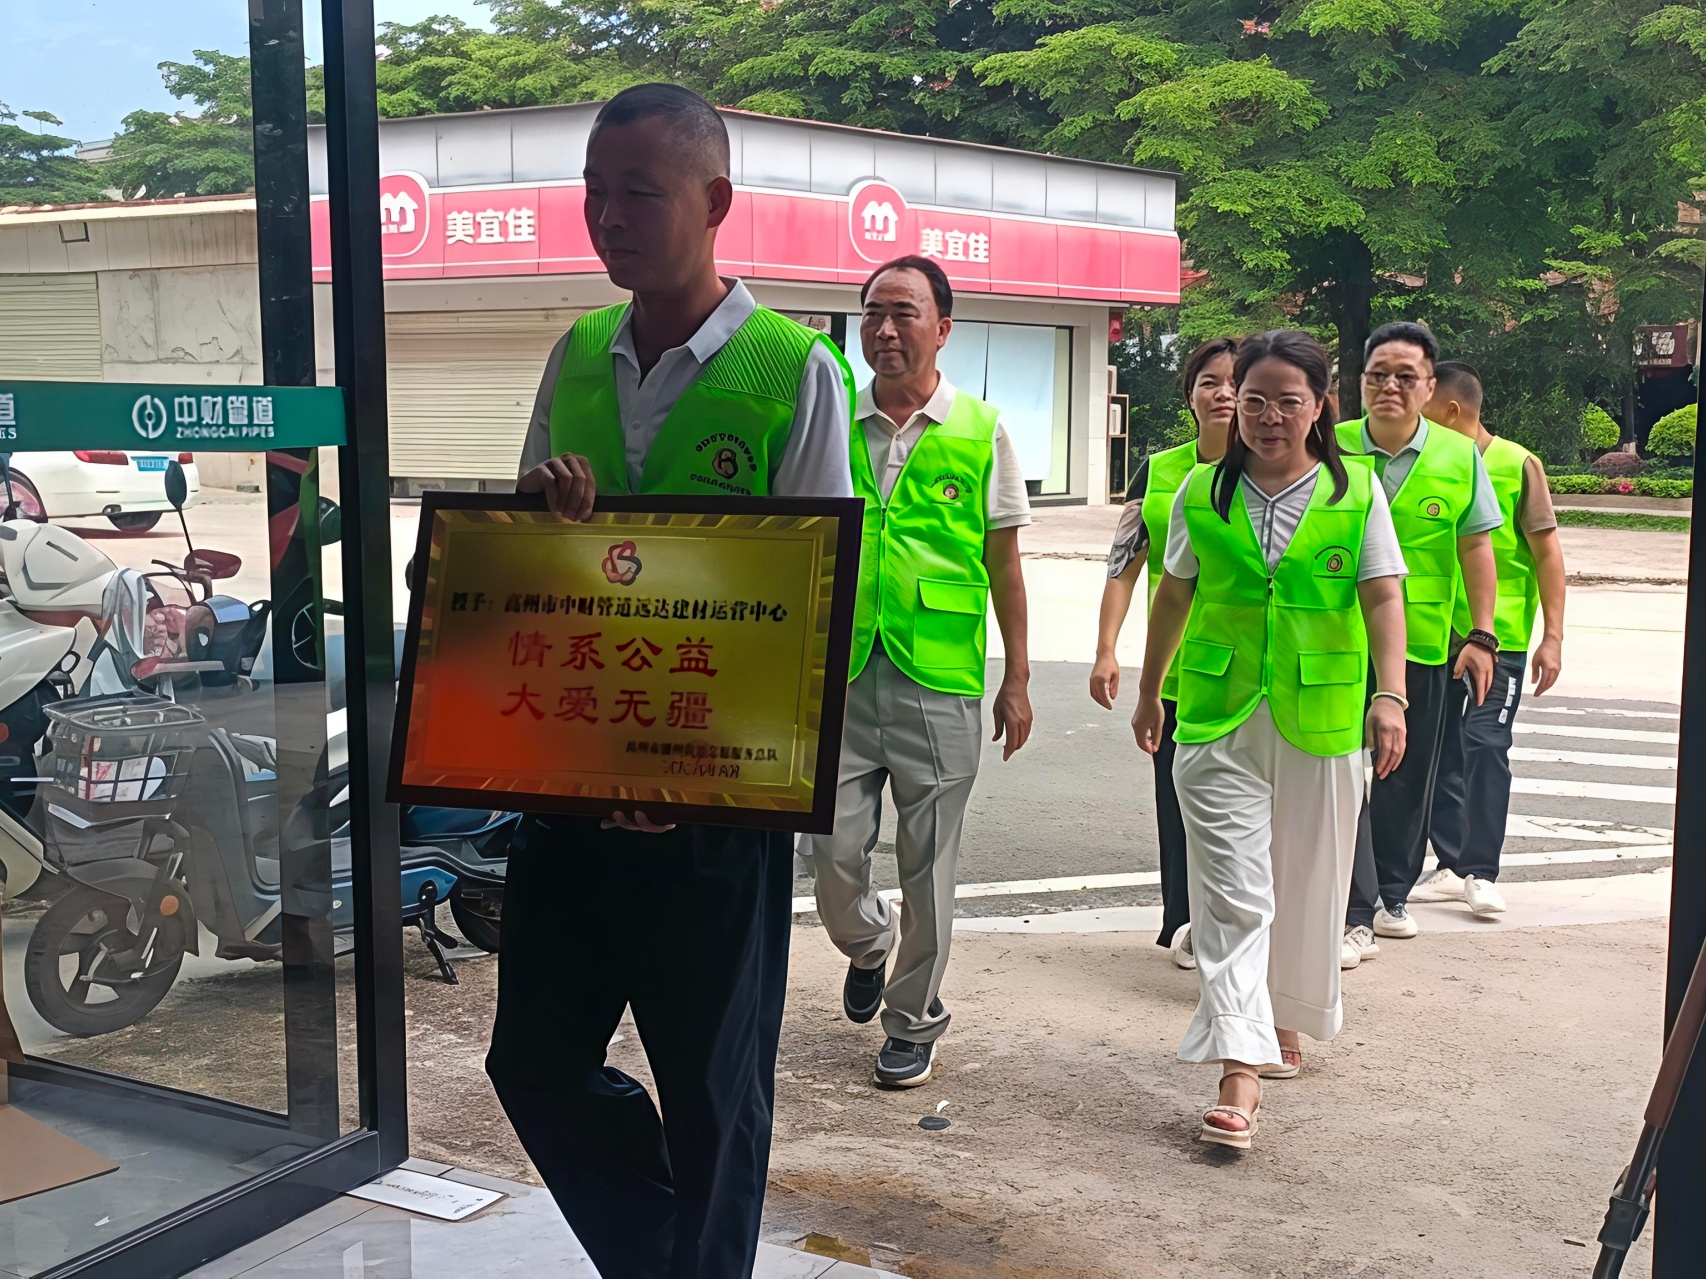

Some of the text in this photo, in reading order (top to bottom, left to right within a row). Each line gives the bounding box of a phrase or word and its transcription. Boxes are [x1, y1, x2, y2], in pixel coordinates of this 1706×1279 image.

[445, 206, 536, 245] 美宜佳
[920, 228, 990, 263] 美宜佳
[174, 395, 274, 425] 中财管道
[508, 630, 718, 678] 情系公益
[501, 683, 713, 730] 大爱无疆
